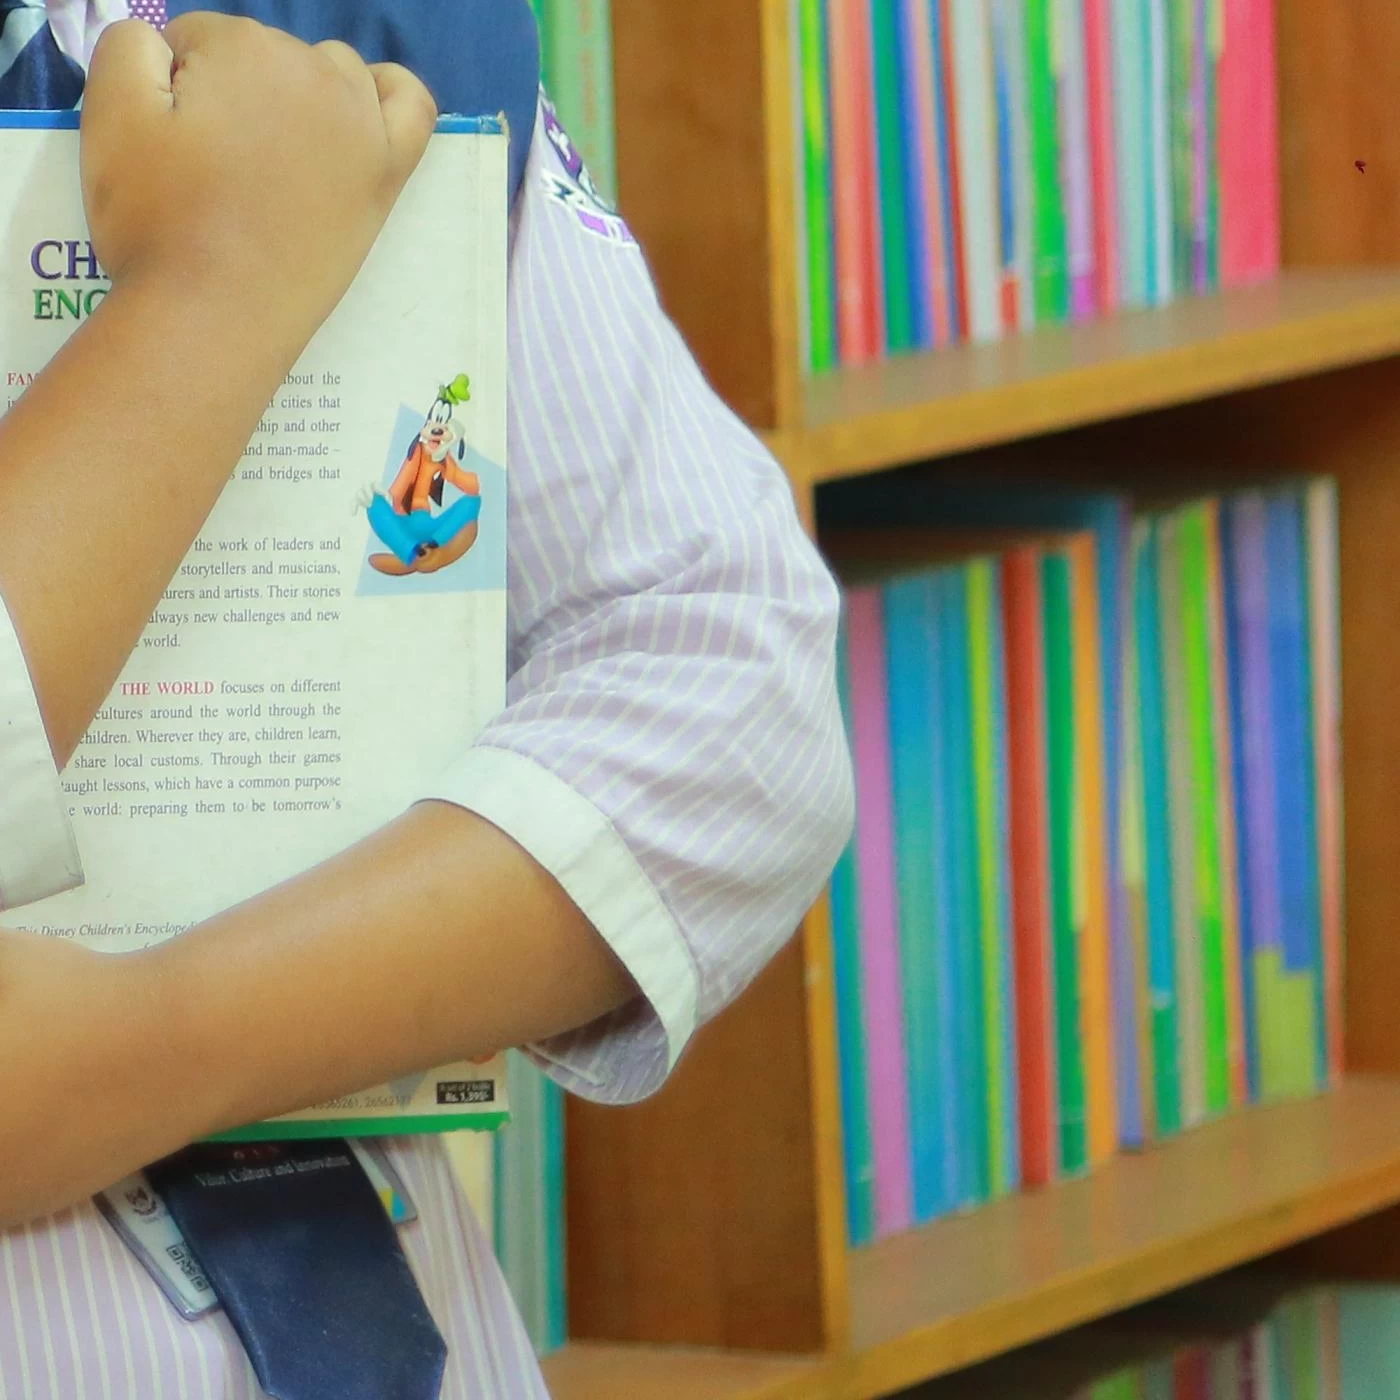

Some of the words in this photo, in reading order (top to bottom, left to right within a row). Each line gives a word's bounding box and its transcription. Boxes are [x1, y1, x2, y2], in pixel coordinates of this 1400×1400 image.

[283, 371, 314, 386] bout
[322, 371, 341, 385] the
[281, 395, 313, 409] cities
[319, 395, 341, 409] that
[284, 419, 306, 433] and
[310, 419, 341, 433] other
[267, 443, 329, 456] man-made
[241, 467, 263, 480] and
[269, 467, 313, 483] bridges
[319, 467, 341, 480] that
[195, 538, 213, 552] the
[218, 538, 249, 552] work
[254, 537, 269, 551] of
[272, 537, 314, 551] leaders
[319, 537, 341, 551] and
[180, 562, 247, 579] storytellers
[251, 562, 274, 575] and
[278, 561, 341, 576] musicians,
[199, 585, 221, 599] and
[224, 585, 262, 599] artists.
[266, 584, 298, 598] Their
[302, 583, 342, 598] stories
[194, 611, 218, 623] new
[223, 609, 286, 626] challenges
[290, 608, 313, 622] and
[316, 610, 341, 622] new
[143, 633, 181, 648] world.
[120, 681, 151, 696] THE
[157, 681, 215, 696] WORLD
[220, 679, 265, 694] focuses
[270, 683, 285, 694] on
[291, 679, 341, 694] different
[94, 706, 143, 721] cultures
[150, 705, 193, 719] around
[200, 704, 219, 718] the
[226, 703, 262, 718] world
[268, 703, 316, 720] through
[322, 703, 341, 717] the
[136, 729, 194, 744] Wherever
[198, 728, 223, 745] they
[228, 731, 250, 744] are,
[255, 727, 304, 742] children
[308, 726, 341, 742] learn,
[74, 754, 107, 769] share
[114, 753, 144, 768] local
[150, 753, 204, 767] customs.
[210, 751, 262, 769] Through
[269, 750, 296, 765] their
[303, 753, 341, 768] games
[103, 777, 150, 793] lessons,
[154, 776, 191, 790] which
[195, 775, 223, 789] have
[238, 776, 291, 789] common
[295, 776, 341, 792] purpose
[83, 801, 122, 816] world:
[130, 799, 188, 818] preparing
[195, 799, 226, 813] them
[233, 800, 246, 812] to
[251, 798, 267, 812] be
[272, 796, 342, 812] tomorrow's
[41, 925, 76, 938] Disney
[79, 923, 131, 937] Children's
